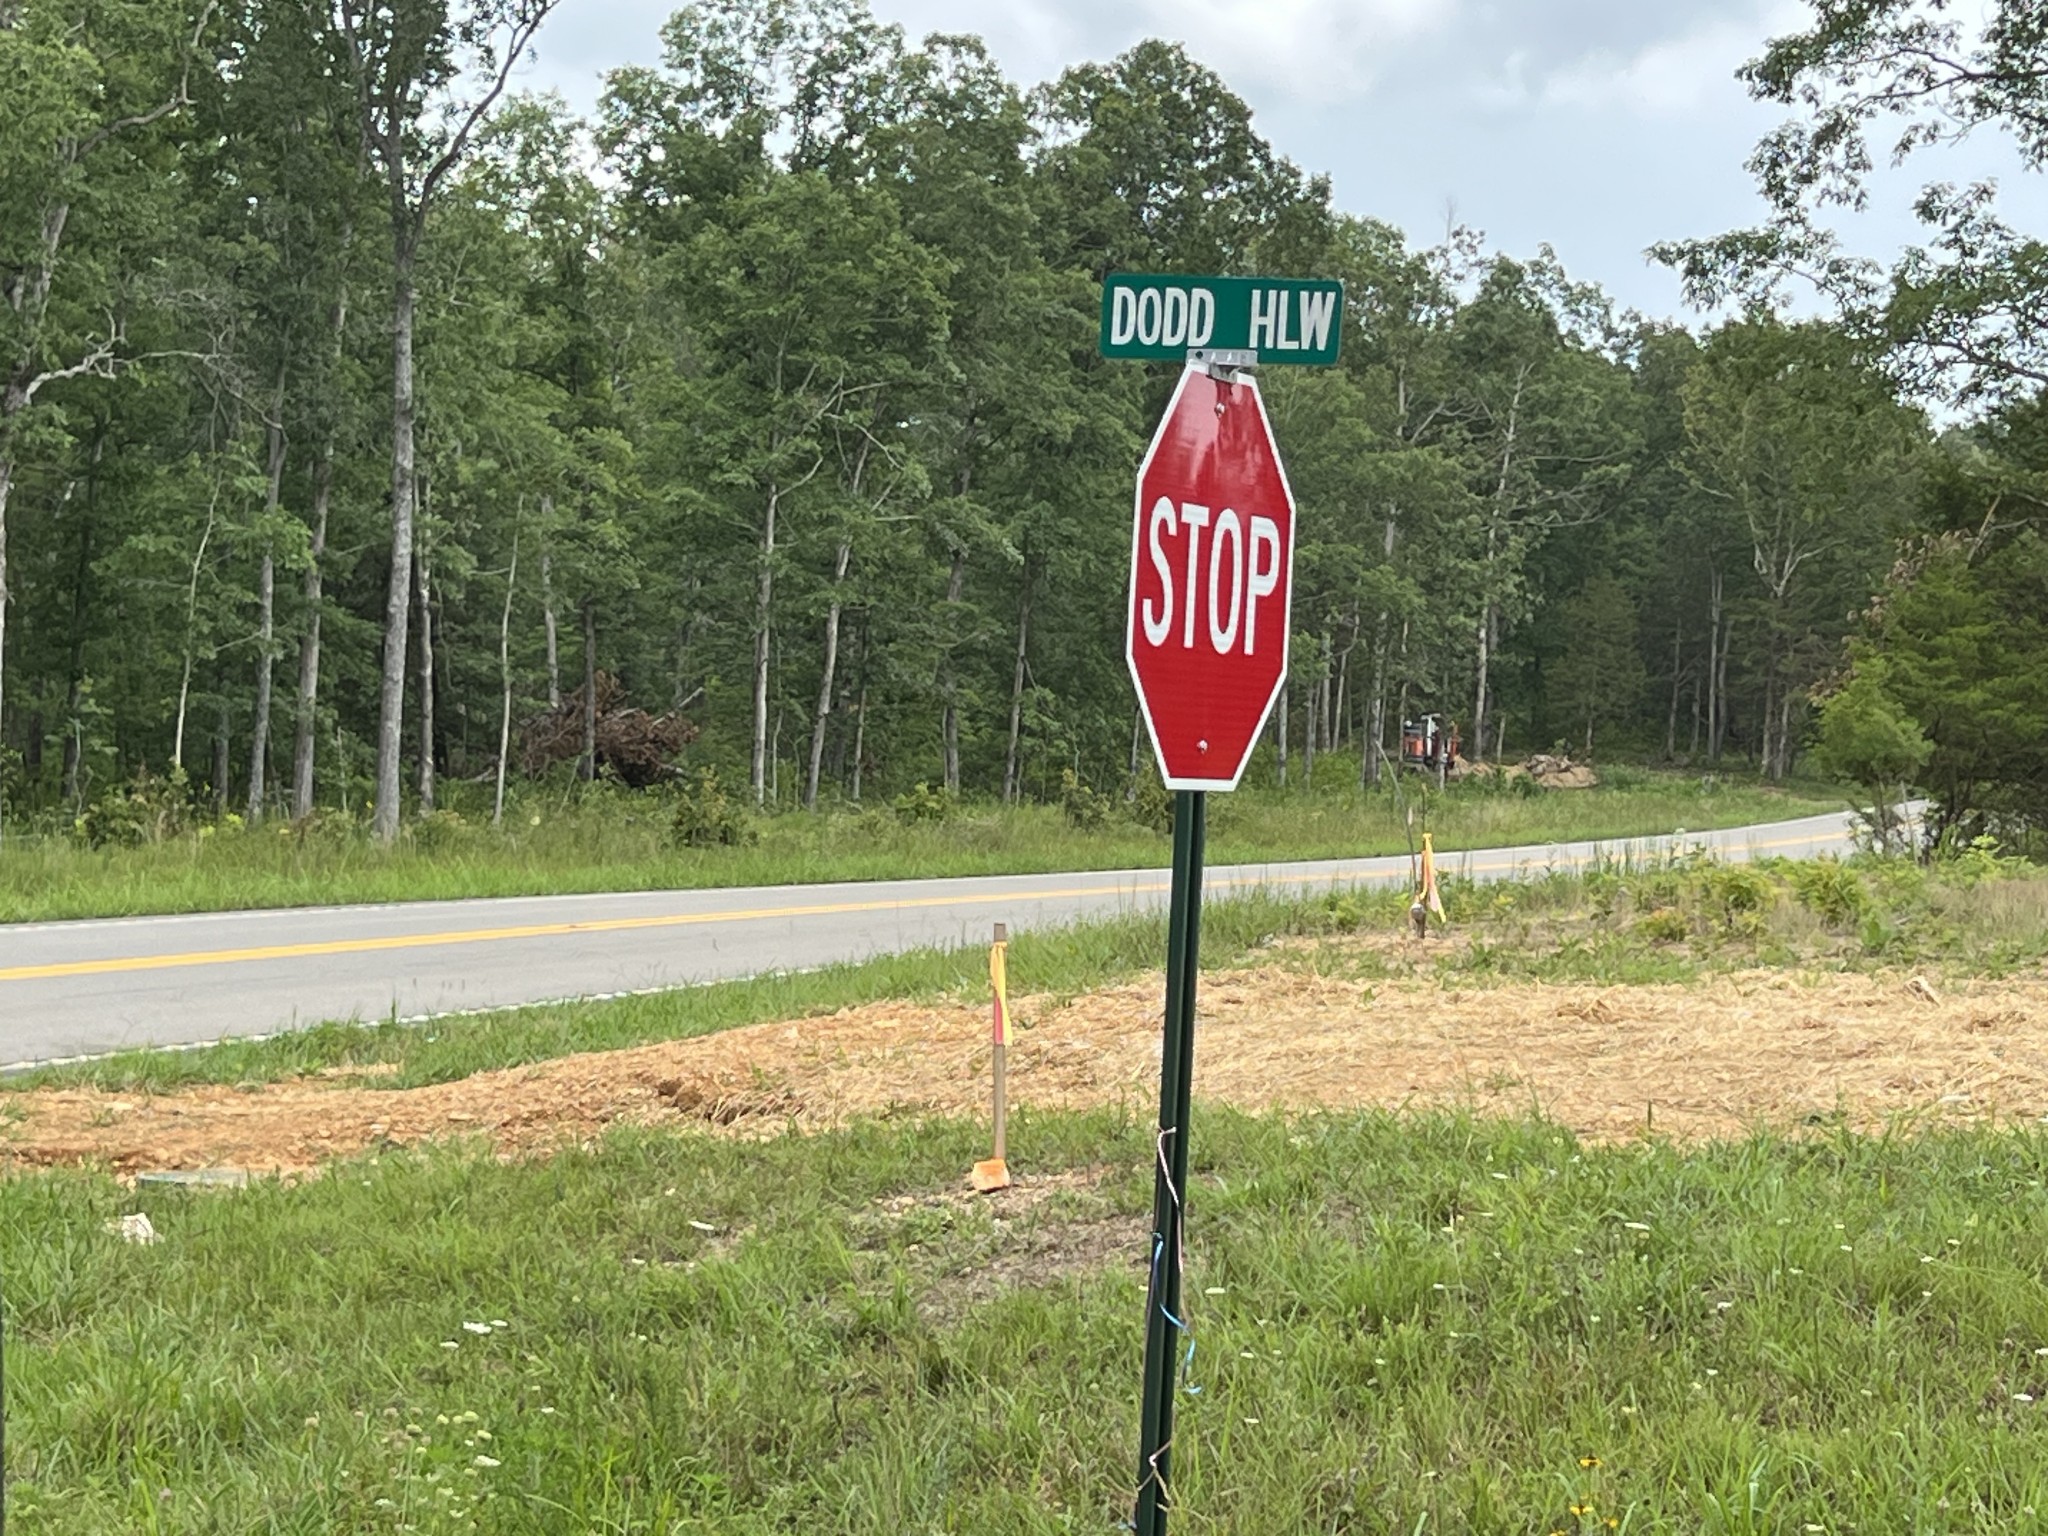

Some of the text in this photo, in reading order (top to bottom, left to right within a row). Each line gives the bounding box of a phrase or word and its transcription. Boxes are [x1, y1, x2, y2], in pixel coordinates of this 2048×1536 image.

[1110, 286, 1336, 351] DODD HLW
[1142, 495, 1281, 656] STOP
